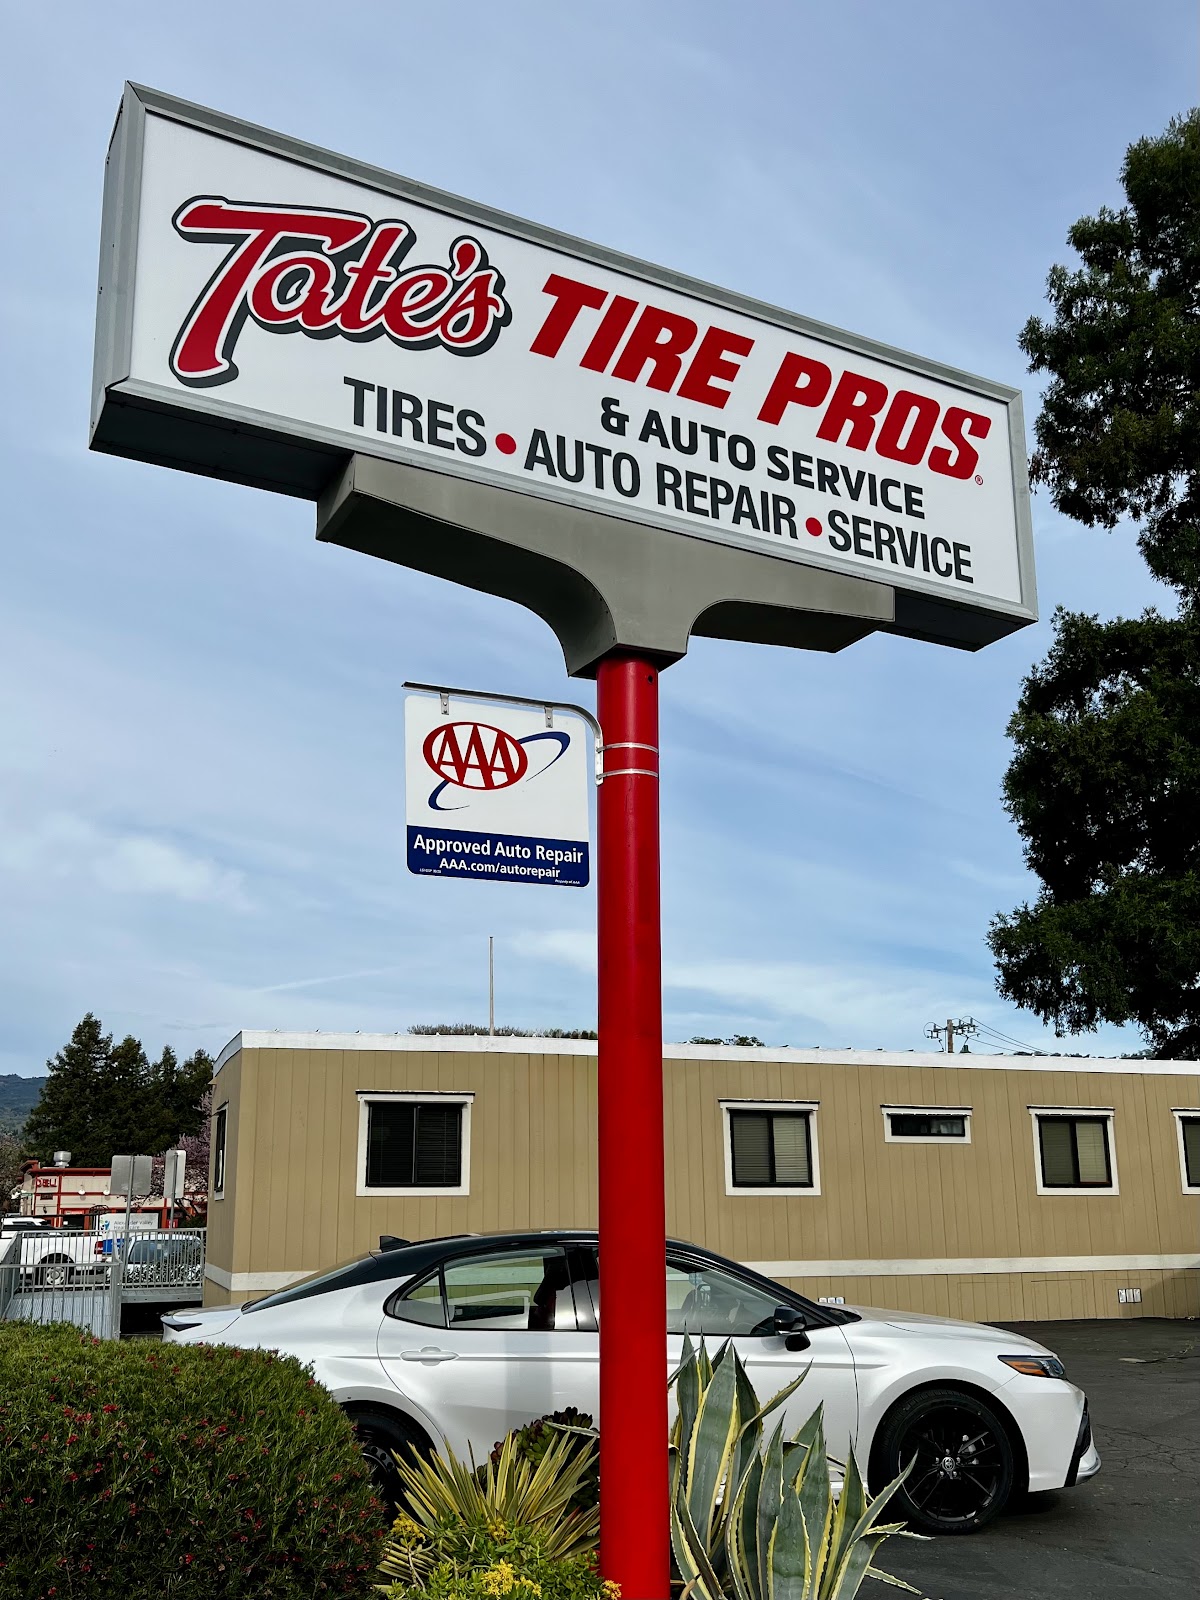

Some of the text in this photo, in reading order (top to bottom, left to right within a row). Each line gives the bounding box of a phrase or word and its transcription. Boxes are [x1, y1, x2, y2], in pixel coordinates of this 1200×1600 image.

[169, 195, 513, 388] Tate's
[529, 273, 992, 480] TIRE PROS
[344, 376, 974, 583] TIRES AUTO REPAIR SERVICE
[601, 397, 925, 519] & AUTO SERVICE
[432, 724, 521, 788] AAA
[413, 834, 584, 865] Approved Auto Repair
[439, 858, 561, 879] AAA.com/autorepair
[36, 1178, 58, 1188] DELI
